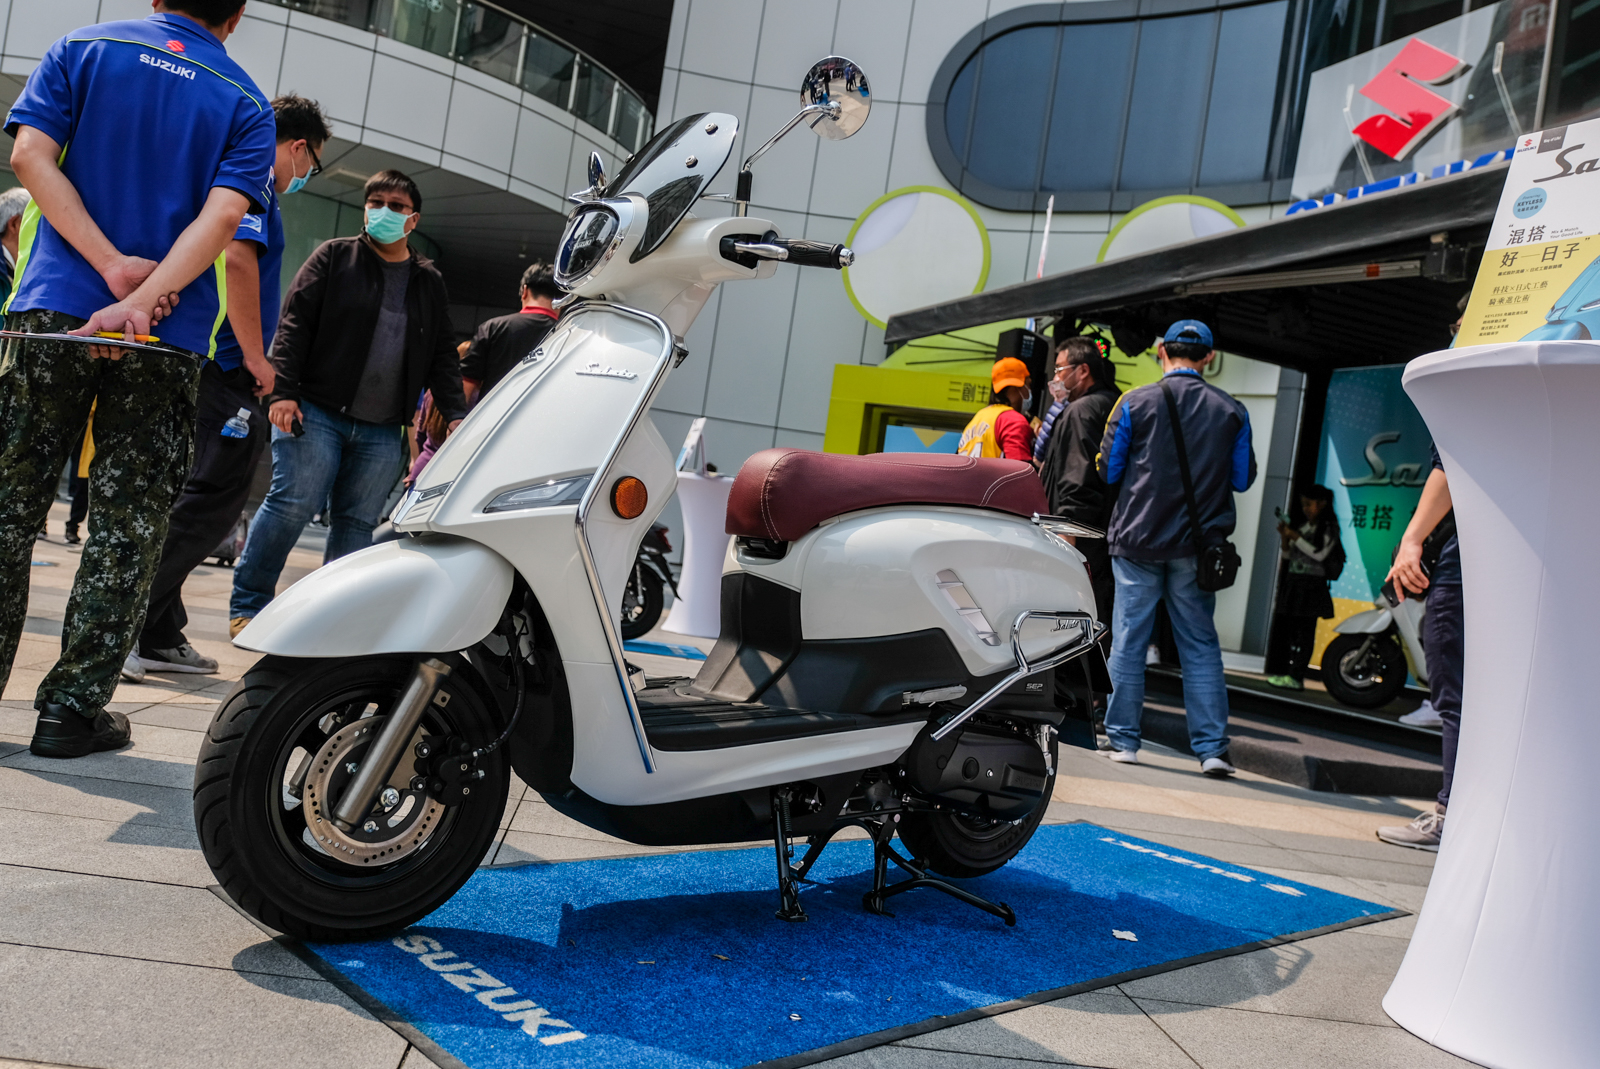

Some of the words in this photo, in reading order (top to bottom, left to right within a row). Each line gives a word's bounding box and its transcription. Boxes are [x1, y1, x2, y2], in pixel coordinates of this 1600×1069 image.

[139, 53, 196, 80] SUZUKI
[1517, 198, 1543, 207] KEYLESS
[1026, 682, 1043, 690] SEP
[392, 935, 588, 1046] SUZUKI
